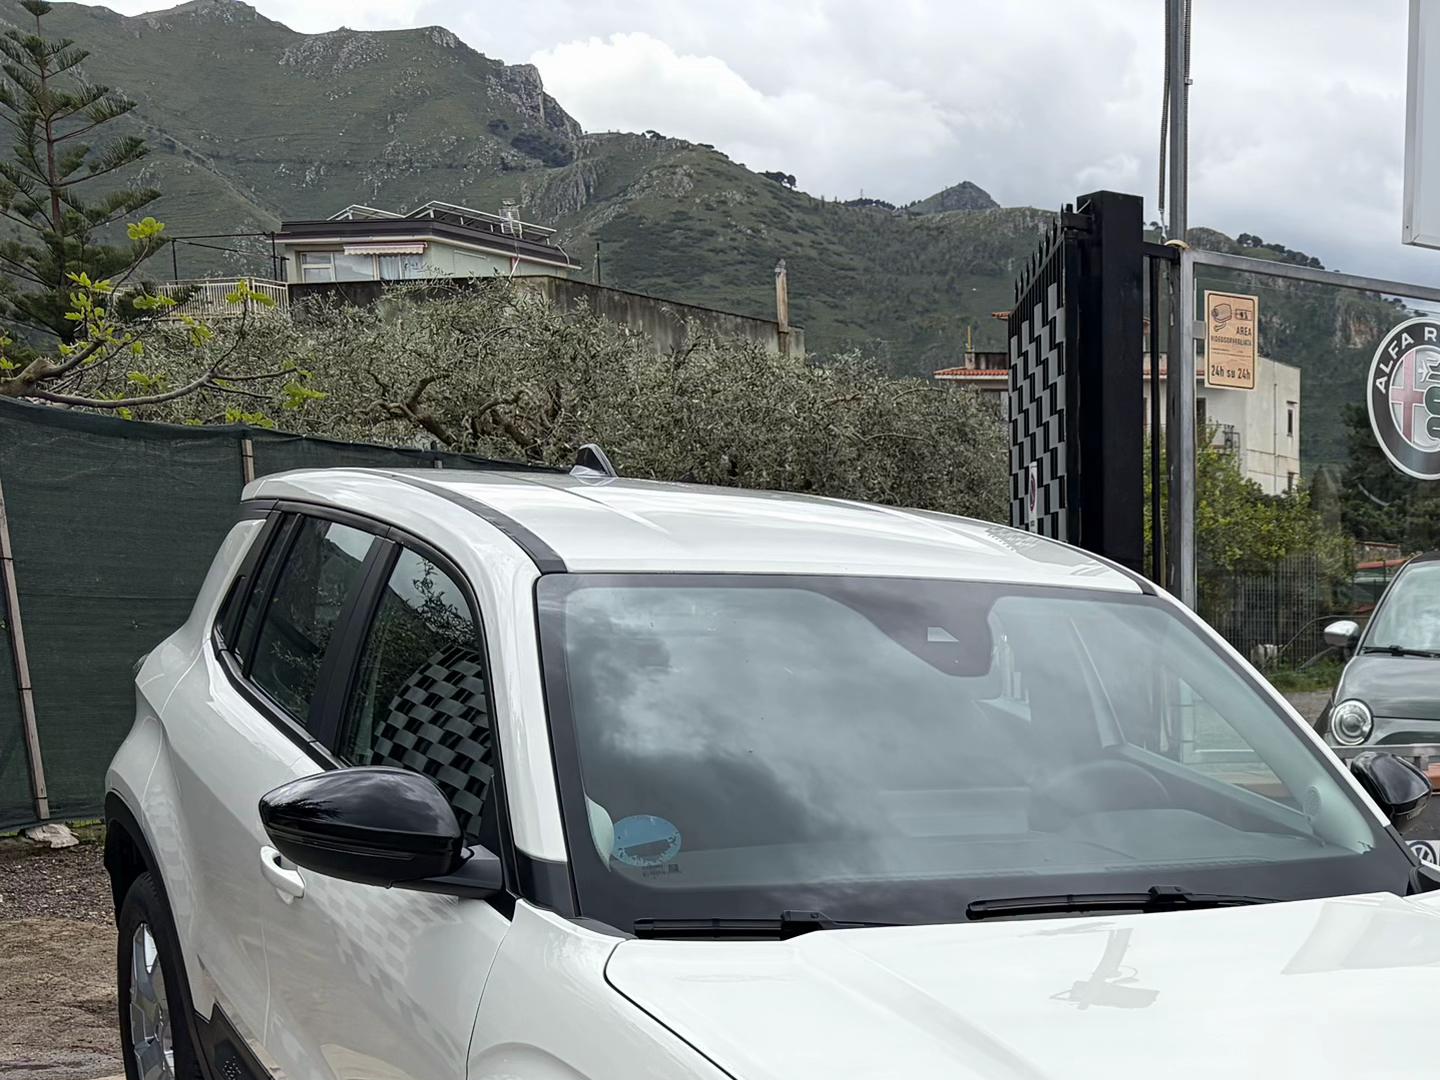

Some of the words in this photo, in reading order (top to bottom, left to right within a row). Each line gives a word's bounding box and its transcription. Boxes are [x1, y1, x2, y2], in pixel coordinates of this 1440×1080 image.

[1236, 326, 1252, 337] AREA
[1375, 332, 1415, 394] ALFA
[1211, 364, 1225, 378] 24h
[1227, 369, 1236, 379] su
[1237, 367, 1251, 380] 24h
